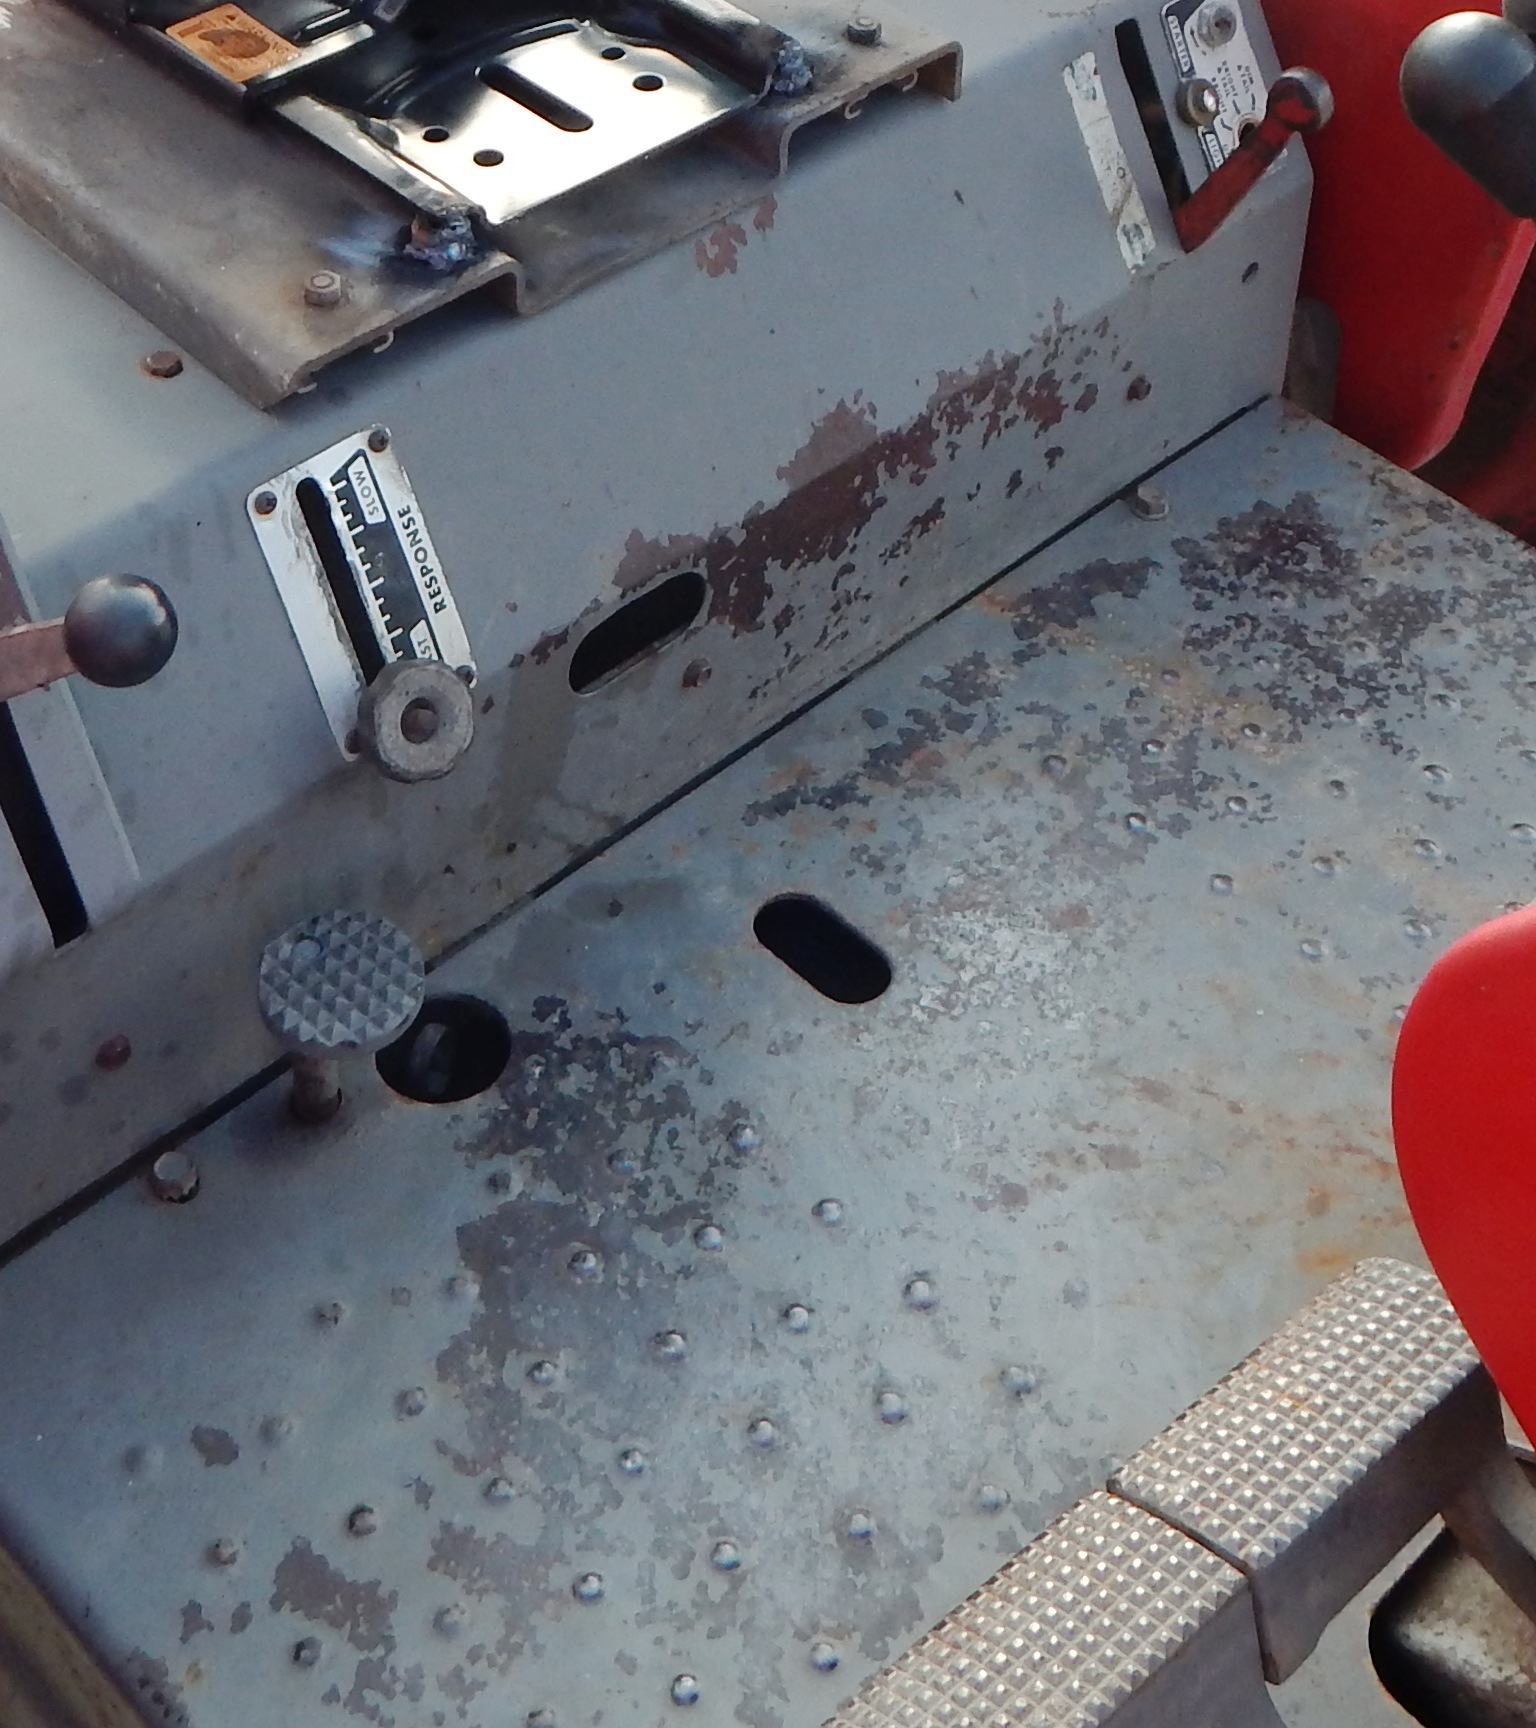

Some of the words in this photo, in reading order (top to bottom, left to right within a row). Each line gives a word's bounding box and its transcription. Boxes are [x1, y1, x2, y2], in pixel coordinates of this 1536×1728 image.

[1168, 16, 1190, 69] STARTER
[353, 469, 380, 517] SLOW
[397, 503, 448, 615] RESPONSE
